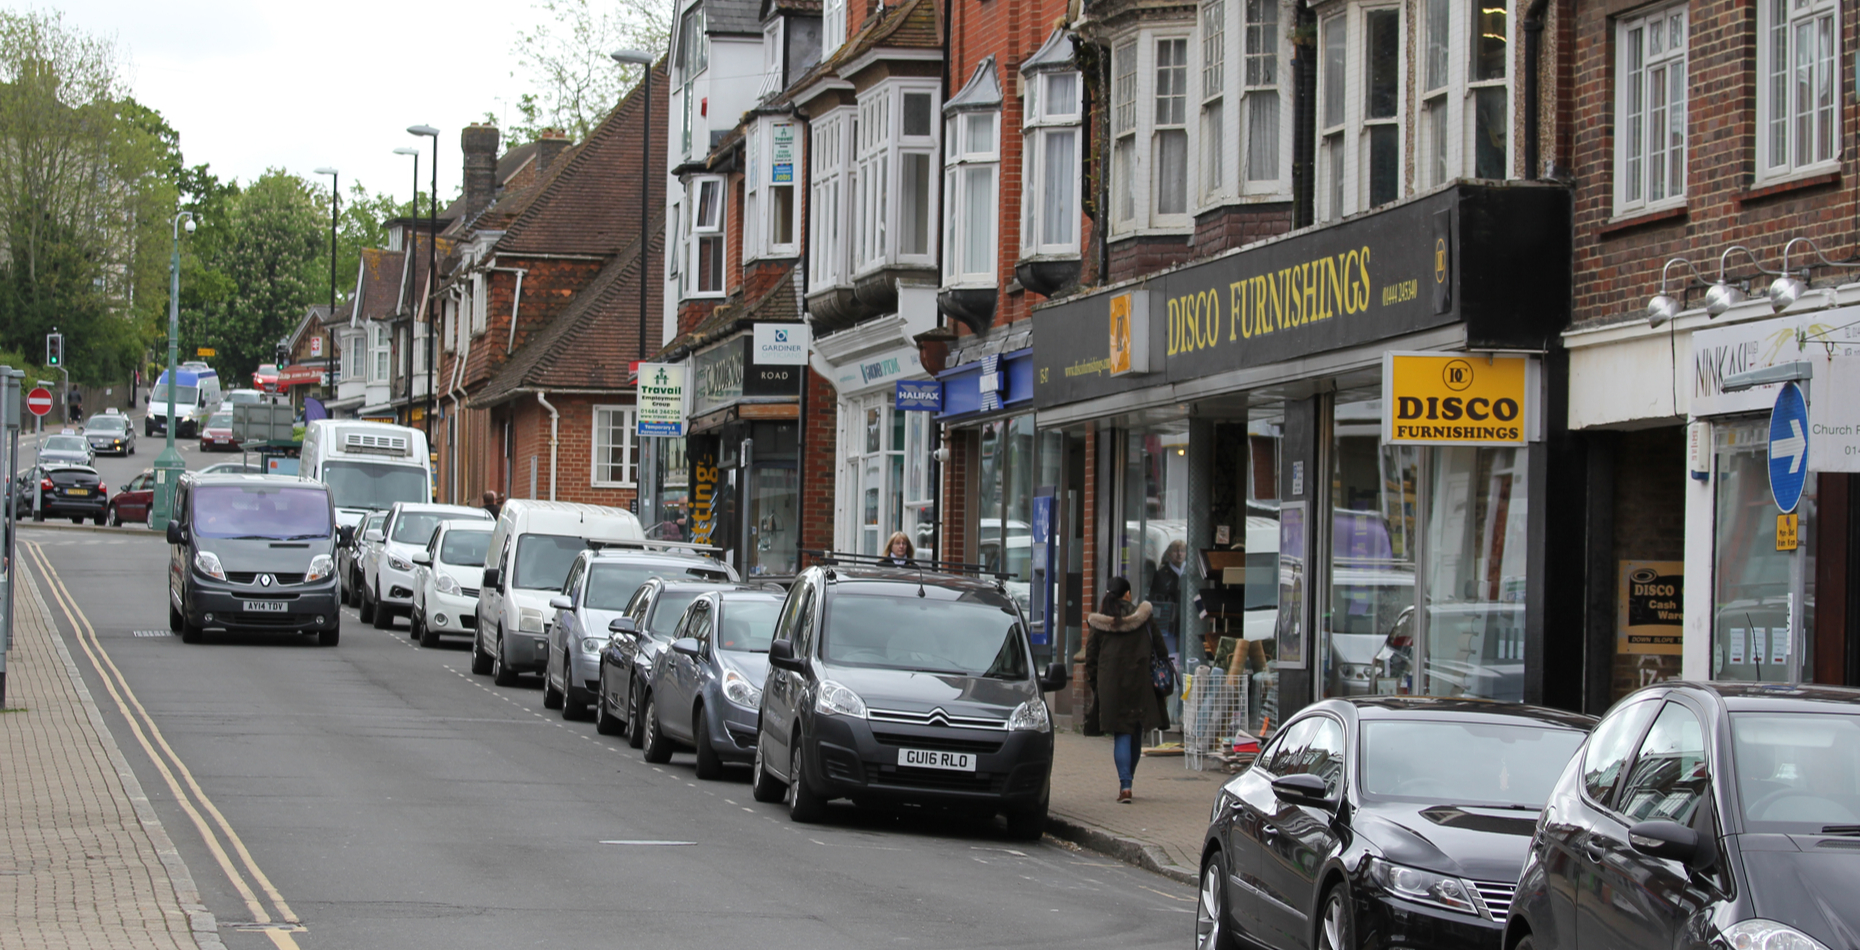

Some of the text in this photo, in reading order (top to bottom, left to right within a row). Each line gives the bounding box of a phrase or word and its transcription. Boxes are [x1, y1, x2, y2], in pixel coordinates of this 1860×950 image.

[1167, 246, 1371, 357] DISCO FURNISHINGS
[761, 371, 789, 380] ROAD
[641, 385, 682, 395] Travail
[898, 391, 939, 400] HALIFAX
[1397, 396, 1519, 422] DISCO
[1397, 425, 1519, 440] FURNISHINGS
[1812, 423, 1852, 435] Church
[1634, 584, 1675, 596] DISCO
[248, 602, 284, 611] AY14 TDV
[1648, 600, 1677, 610] Cash
[906, 750, 968, 768] GU16 RLO
